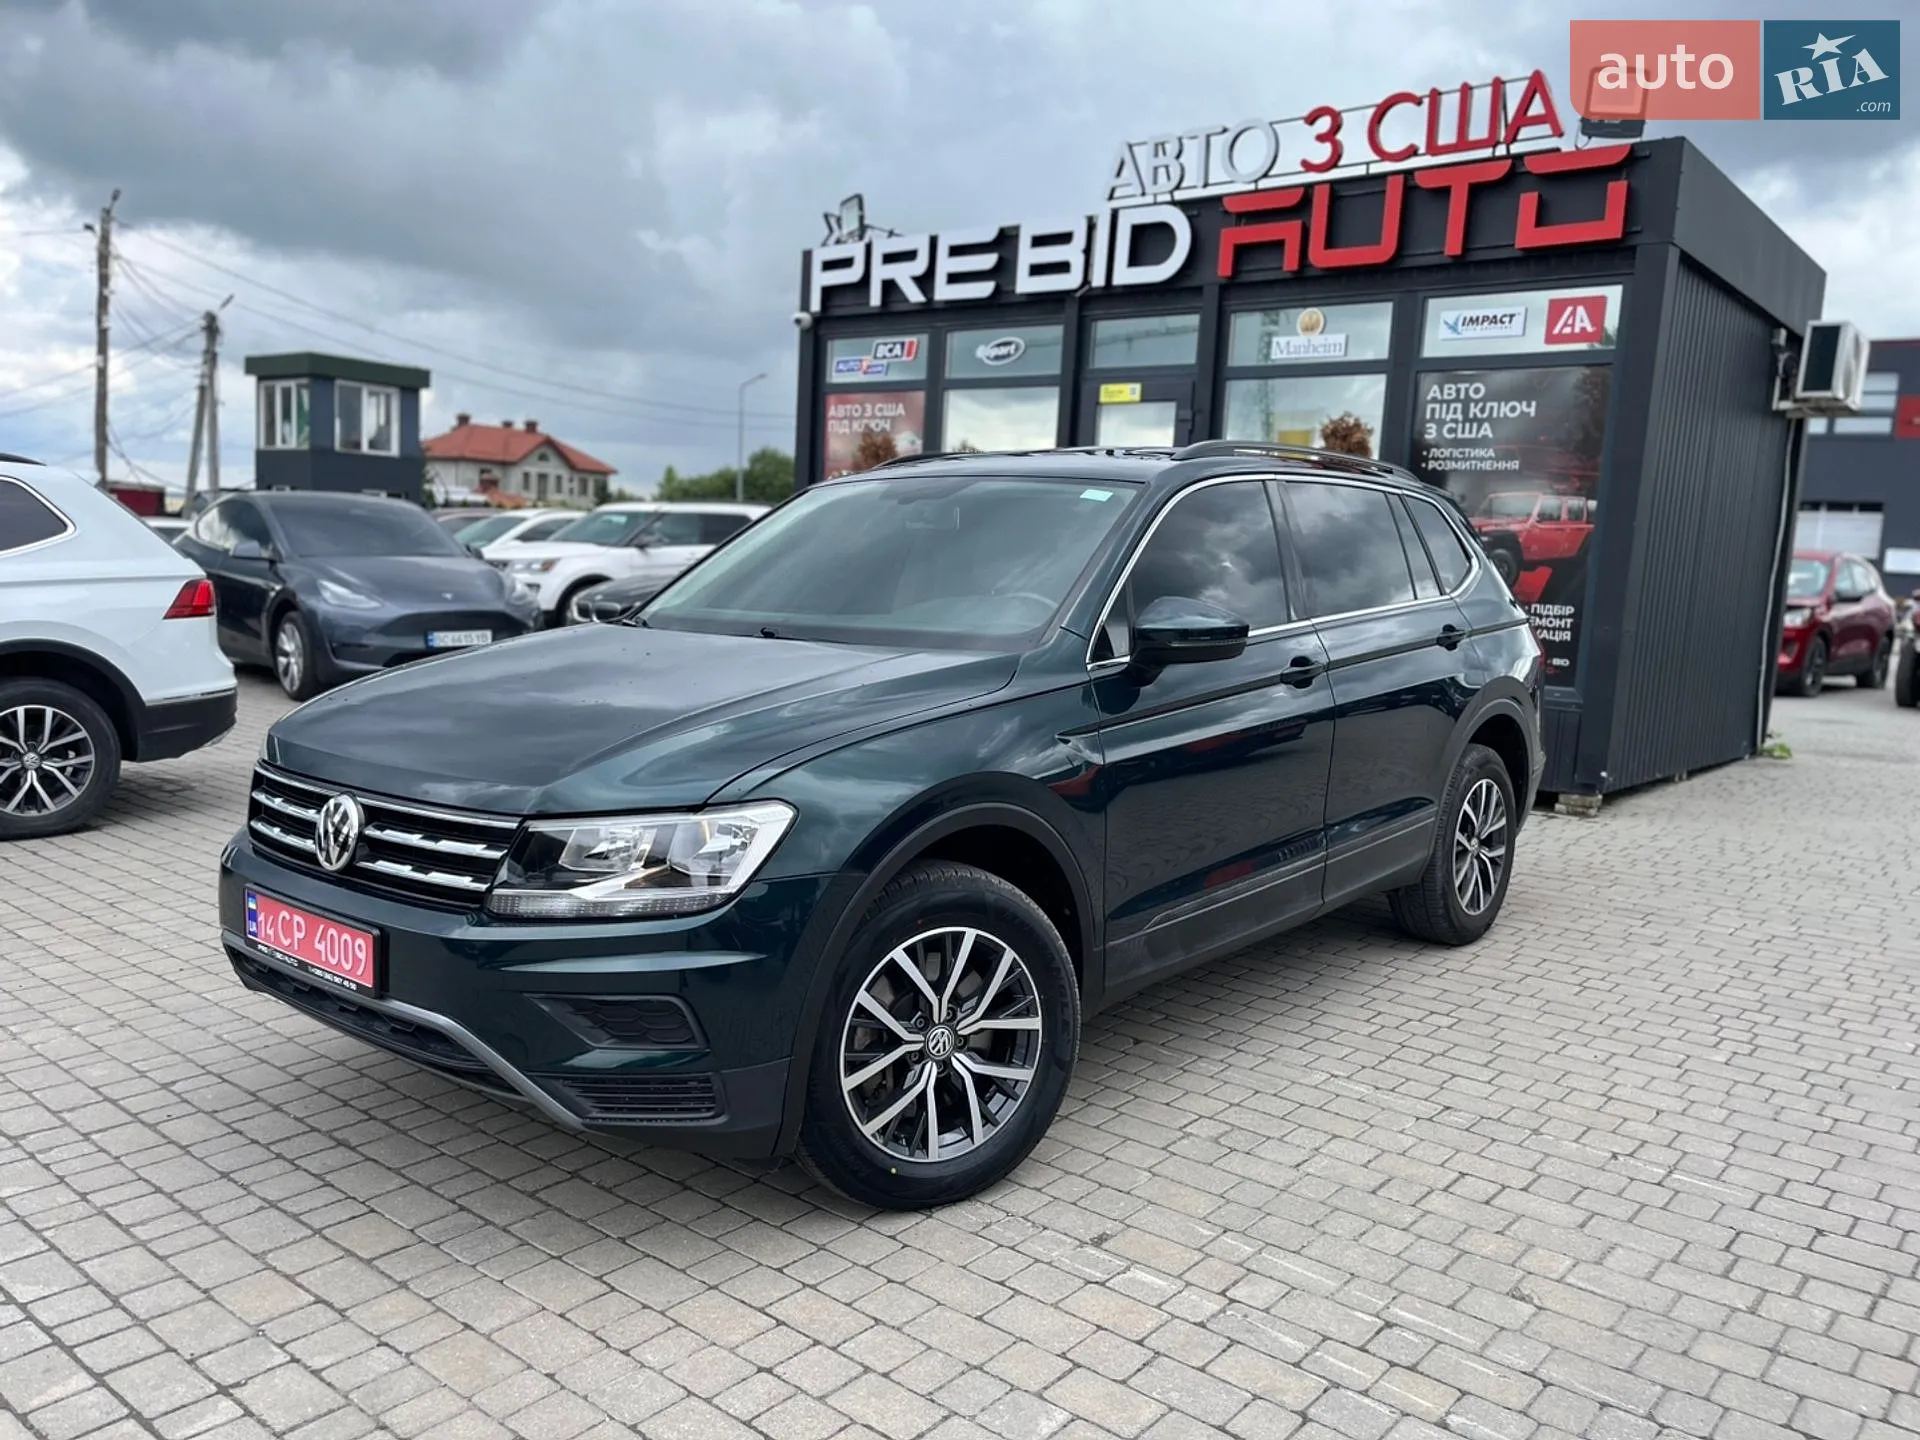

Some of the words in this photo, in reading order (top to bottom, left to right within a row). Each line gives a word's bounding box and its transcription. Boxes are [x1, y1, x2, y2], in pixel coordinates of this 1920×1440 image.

[1107, 118, 1278, 200] АВТО
[1367, 69, 1565, 162] США
[1218, 144, 1633, 278] AUTO
[1461, 313, 1516, 327] IMPACT
[876, 342, 902, 358] BCA
[1274, 337, 1343, 357] Manheim
[1426, 382, 1486, 400] АВТО
[828, 403, 861, 418] АВТО
[876, 403, 906, 417] США
[1425, 402, 1463, 421] ПІД
[1469, 400, 1536, 418] КЛЮЧ
[828, 420, 849, 434] ПІД
[1442, 422, 1493, 439] США
[1428, 448, 1495, 458] ЛОГІСТИКА
[1427, 459, 1520, 471] РОЗМИТНЕННЯ
[1530, 603, 1575, 617] ПІДБІР
[1529, 616, 1574, 629] ЕМОНТ
[314, 924, 367, 976] 4009
